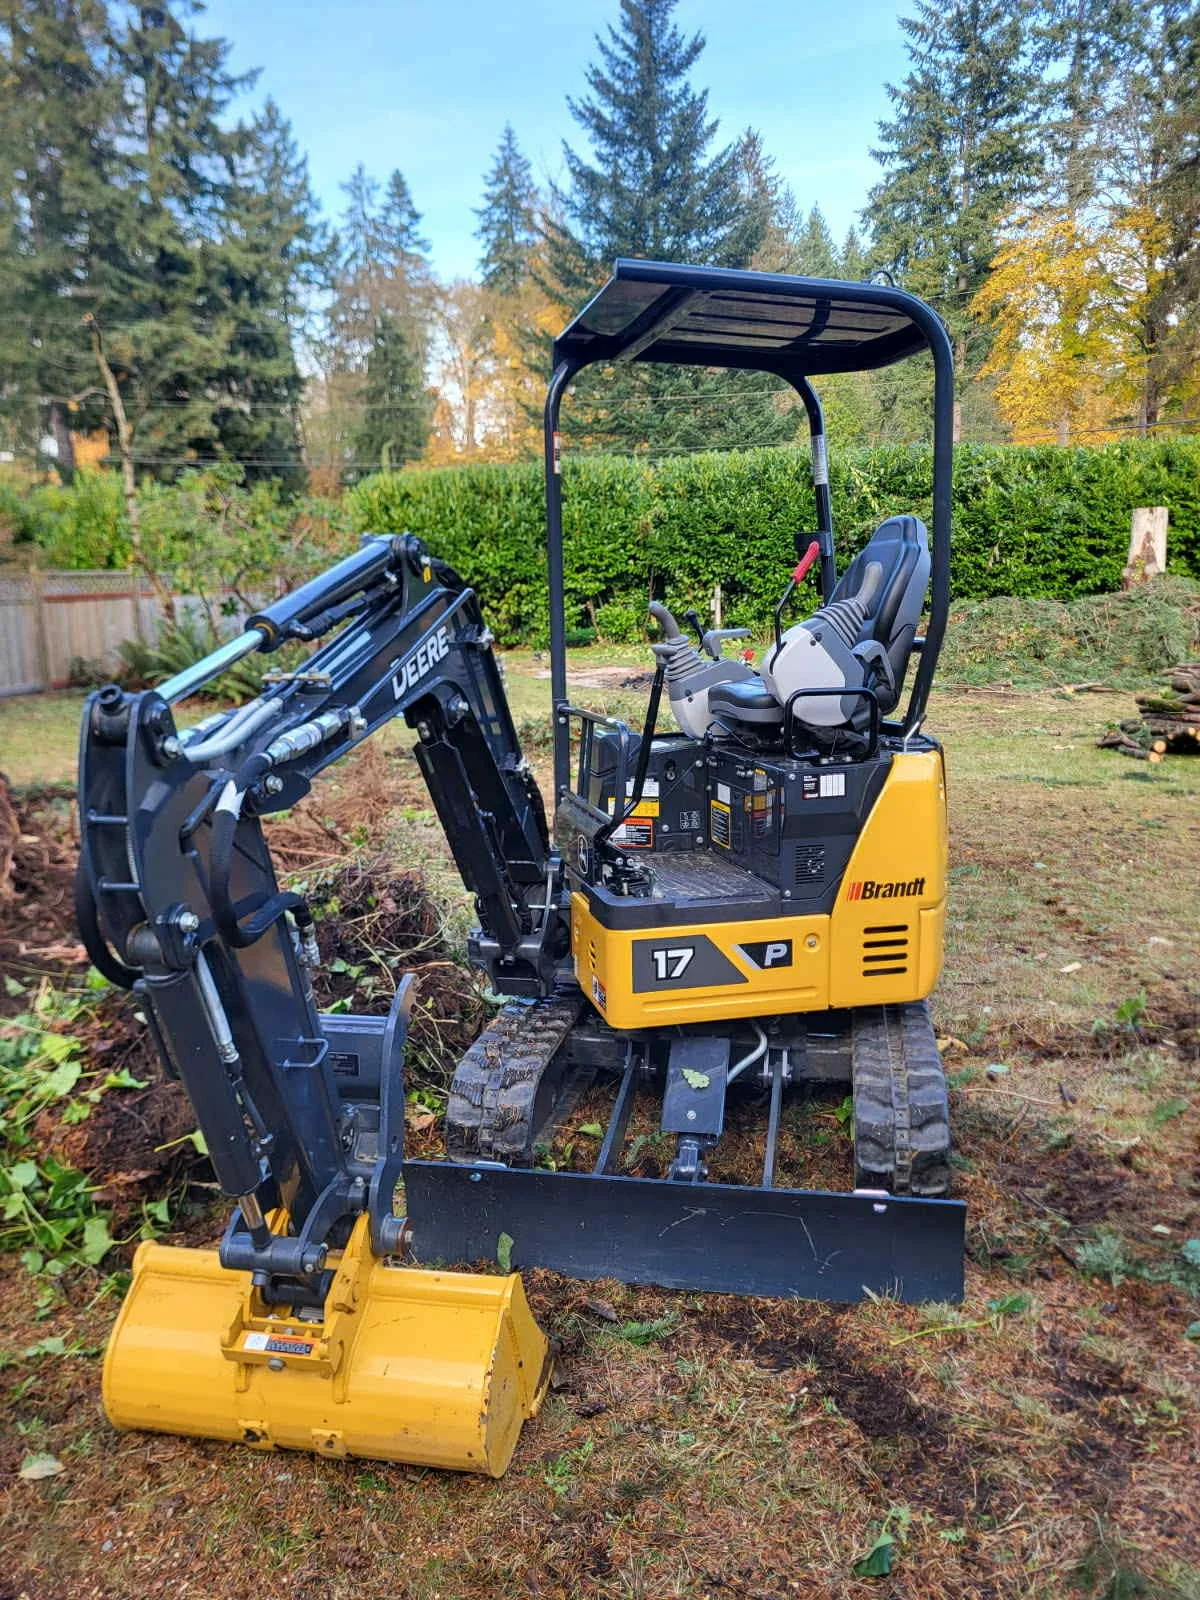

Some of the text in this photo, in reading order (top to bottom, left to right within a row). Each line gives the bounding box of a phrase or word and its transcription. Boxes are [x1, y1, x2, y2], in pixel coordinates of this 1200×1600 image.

[390, 625, 450, 700] DEERE
[861, 877, 926, 900] Brandt
[653, 948, 694, 979] 17
[764, 943, 788, 967] P
